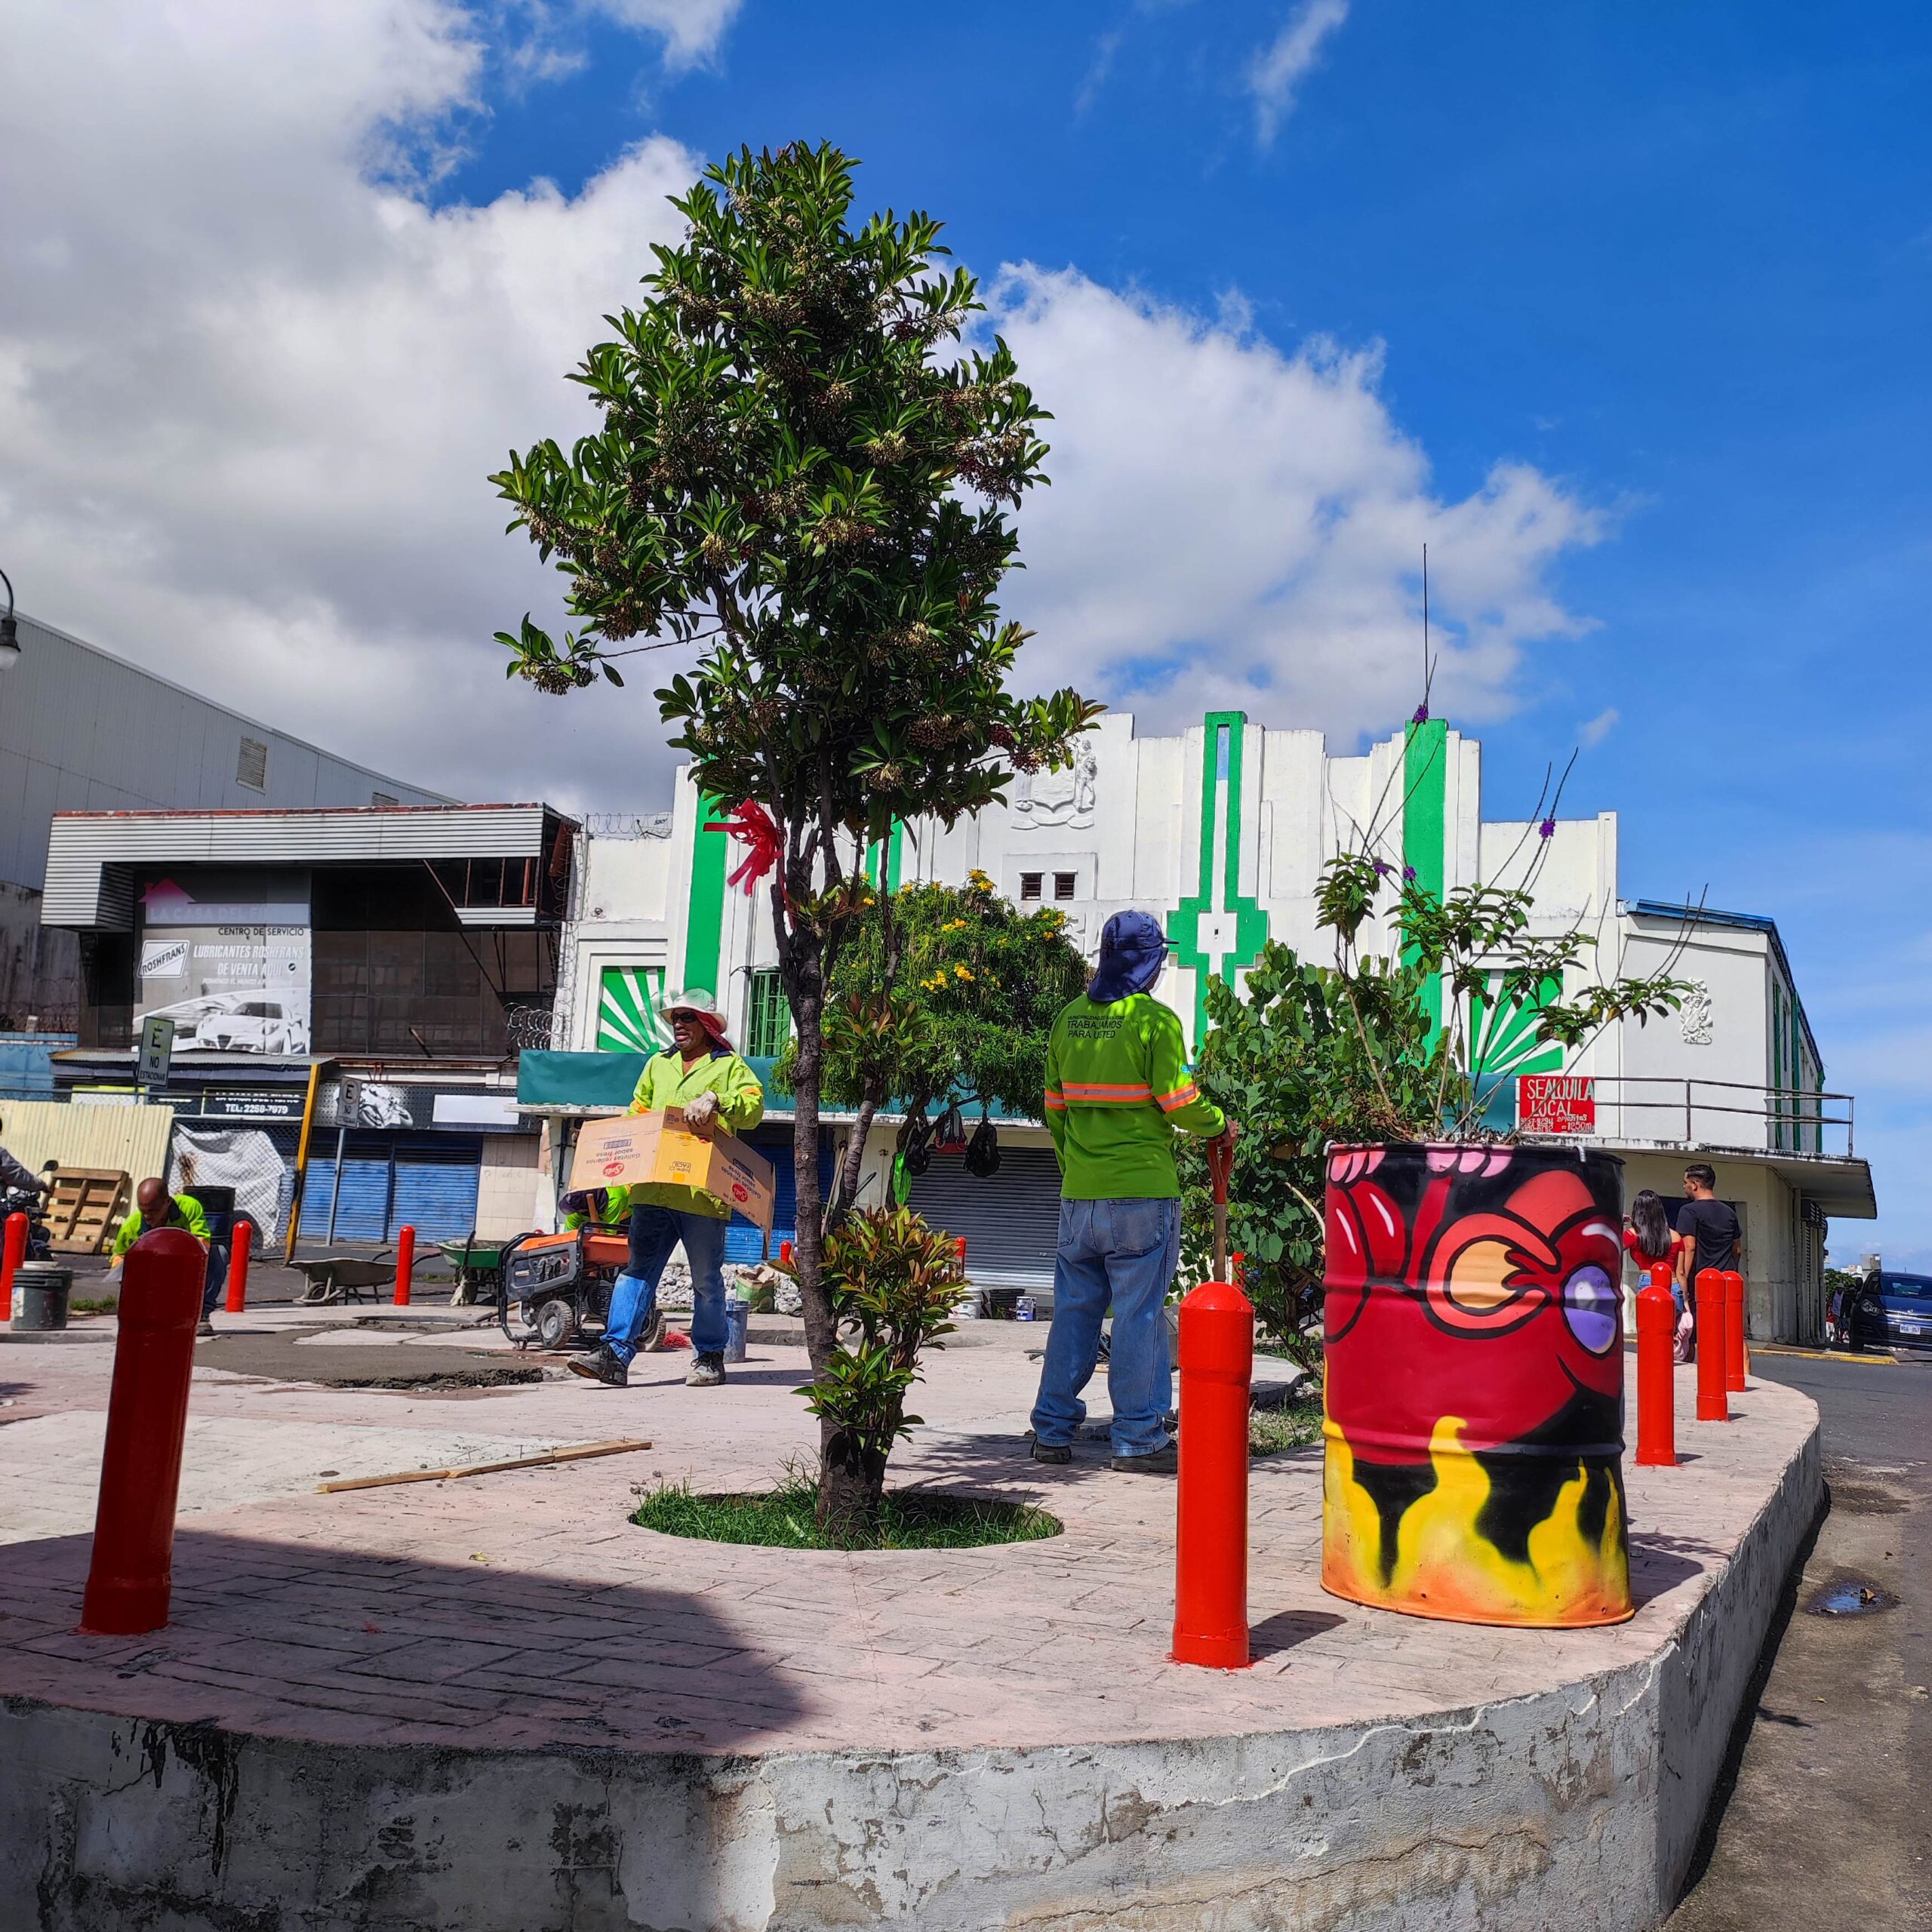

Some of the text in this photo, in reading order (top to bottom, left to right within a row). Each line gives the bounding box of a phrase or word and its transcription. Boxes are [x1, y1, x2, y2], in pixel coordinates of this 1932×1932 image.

[218, 928, 304, 936] CENTRO DE SERVICIO
[193, 945, 305, 959] LUBRICANTES ROSHFRANS
[141, 943, 186, 976] ROSHFRANS
[217, 962, 229, 975] DE
[230, 962, 259, 976] VENTA
[1067, 1020, 1123, 1029] TRABAJAMOS
[1068, 1030, 1116, 1039] PARA USTED
[149, 1057, 160, 1069] NO
[139, 1072, 166, 1081] ESTACIONAR
[1531, 1100, 1577, 1117] LOCAL
[586, 1152, 641, 1164] Galletas rellenas
